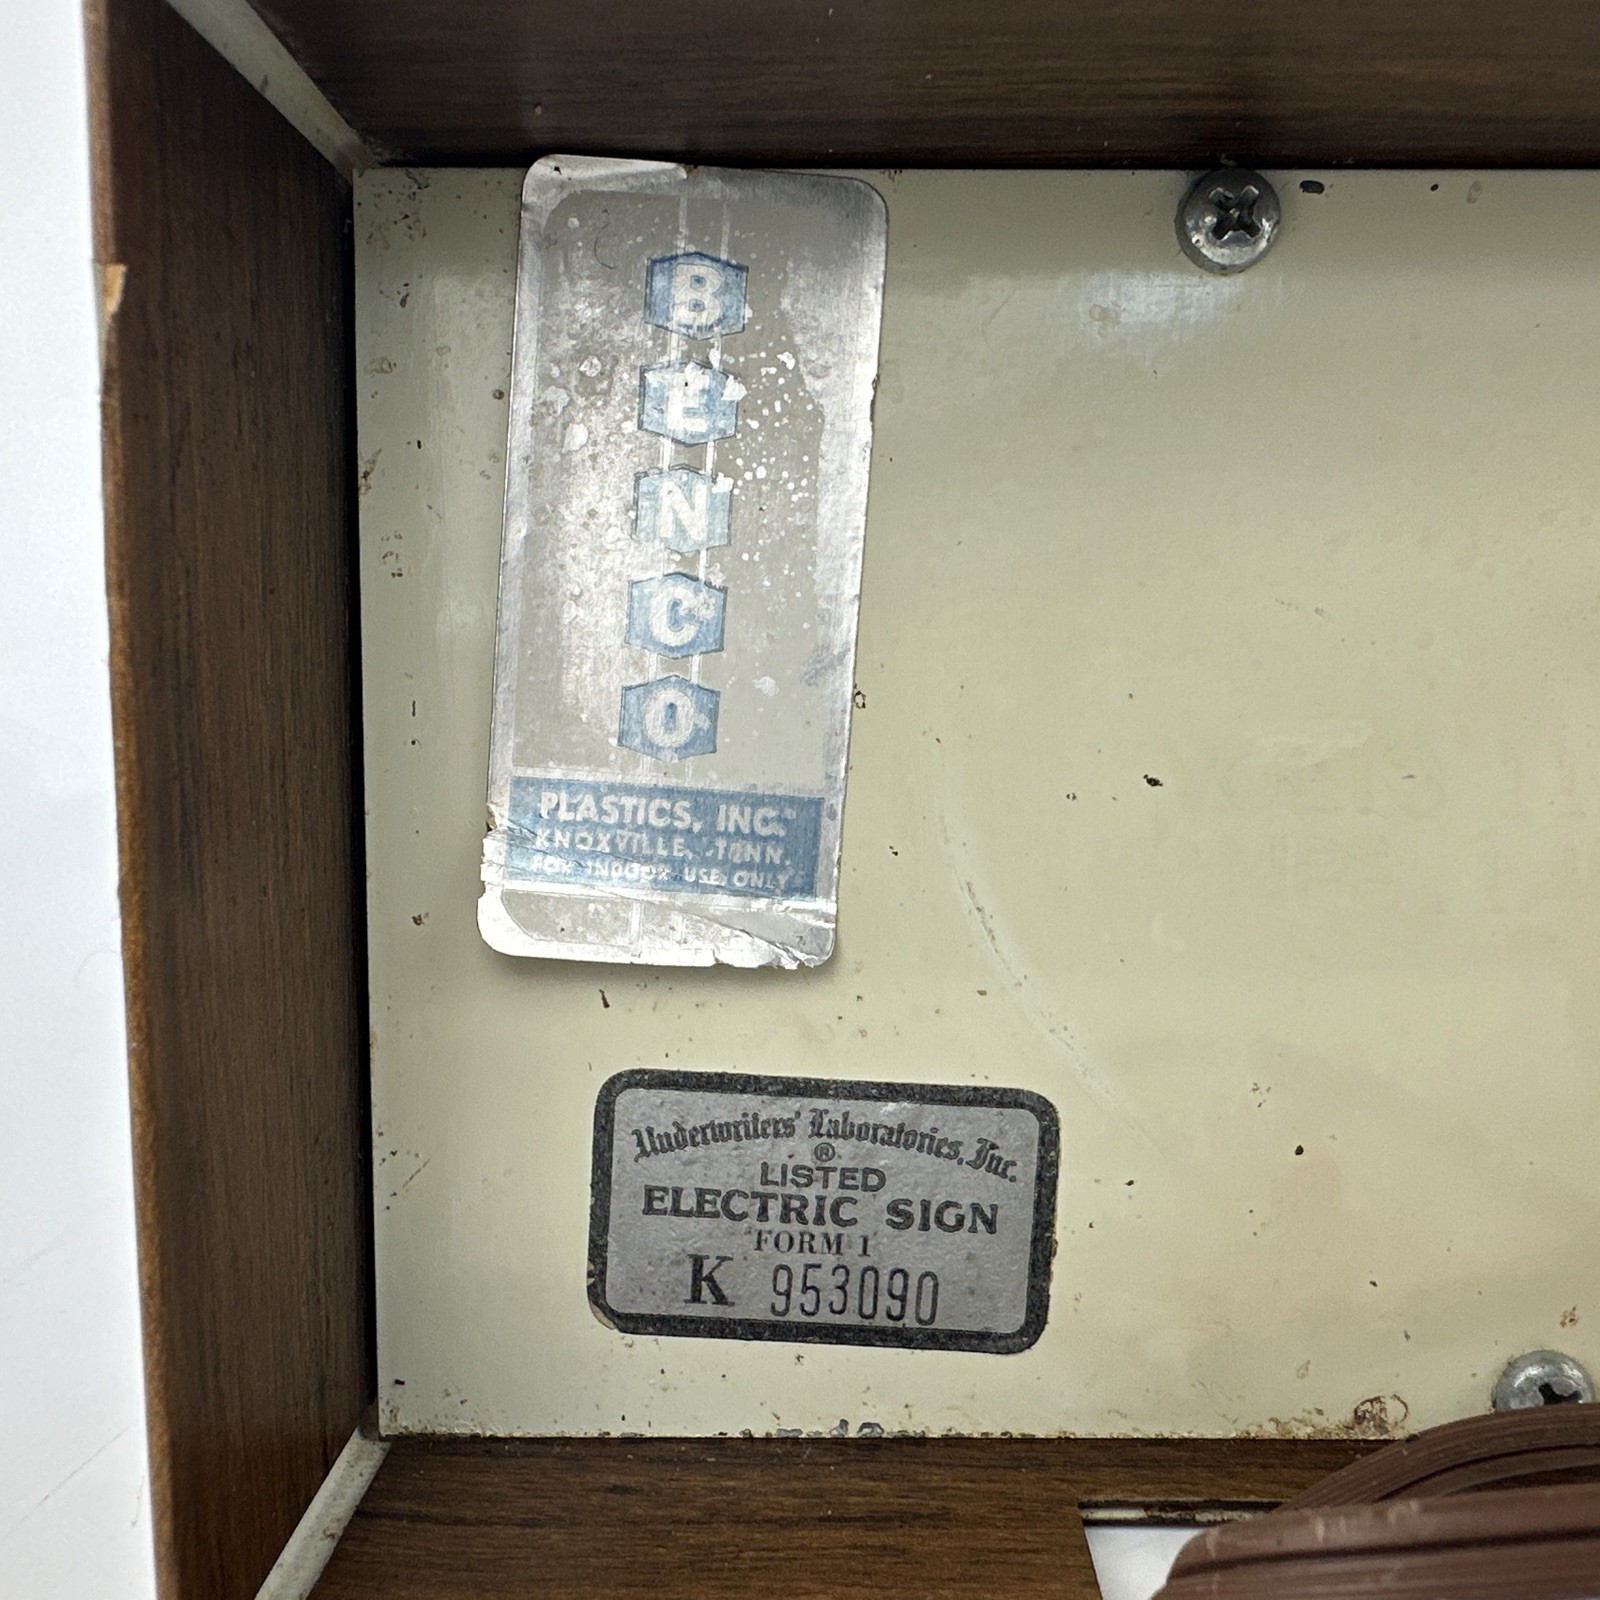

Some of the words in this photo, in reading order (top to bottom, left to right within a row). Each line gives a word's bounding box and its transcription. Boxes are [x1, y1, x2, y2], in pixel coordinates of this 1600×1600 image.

[640, 258, 725, 751] BENCO
[539, 790, 703, 834] PLASTICS,
[808, 1107, 964, 1166] Laboratories,
[965, 1137, 1018, 1183] Inc.
[759, 1161, 886, 1192] LISTED
[642, 1184, 859, 1228] ELECTRIC
[885, 1197, 999, 1235] SIGN
[753, 1229, 843, 1255] FORM
[859, 1234, 872, 1257] 1
[683, 1252, 736, 1307] K
[769, 1263, 940, 1327] 953090
